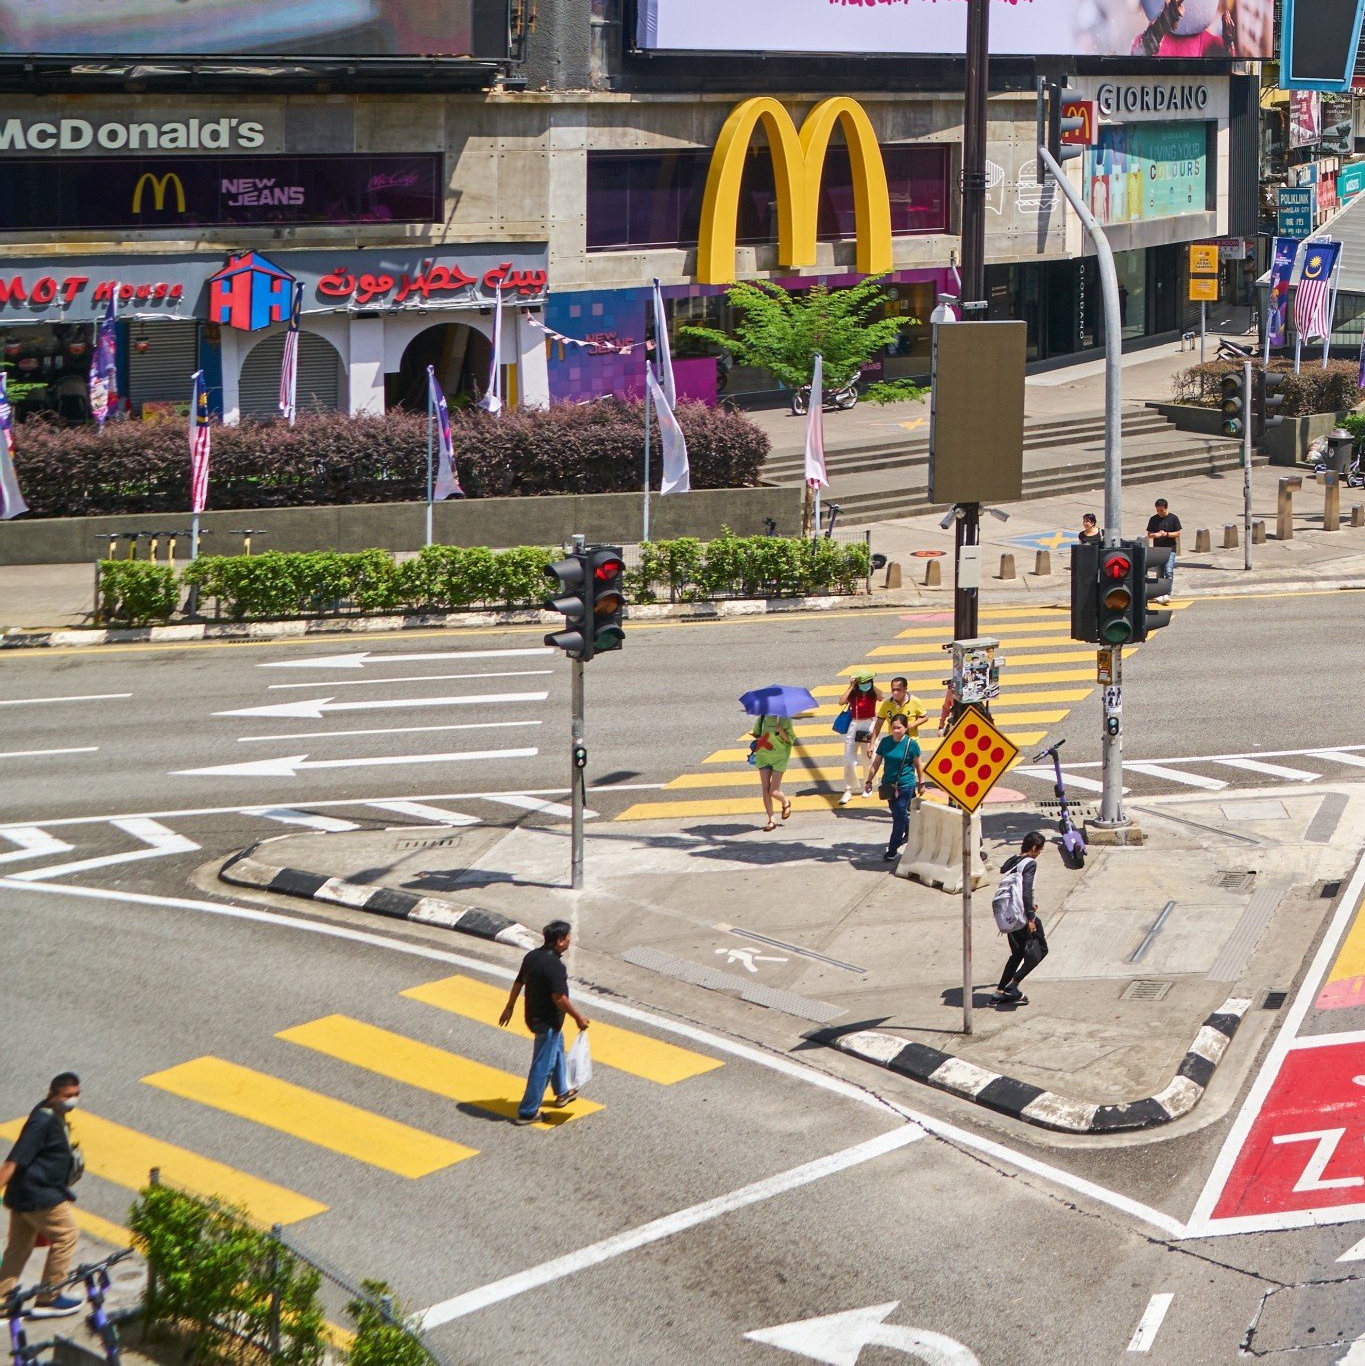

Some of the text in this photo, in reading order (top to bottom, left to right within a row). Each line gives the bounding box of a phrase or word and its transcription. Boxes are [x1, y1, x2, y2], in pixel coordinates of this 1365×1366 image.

[1097, 84, 1209, 115] GIORDANO
[0, 117, 265, 150] McDonald's
[1150, 142, 1201, 162] LIVING YOUR
[1150, 160, 1200, 181] COLOURS
[221, 177, 277, 195] NEW
[228, 186, 305, 207] JEANS
[1280, 193, 1309, 205] POLIKLINIK
[0, 275, 90, 304] MOT
